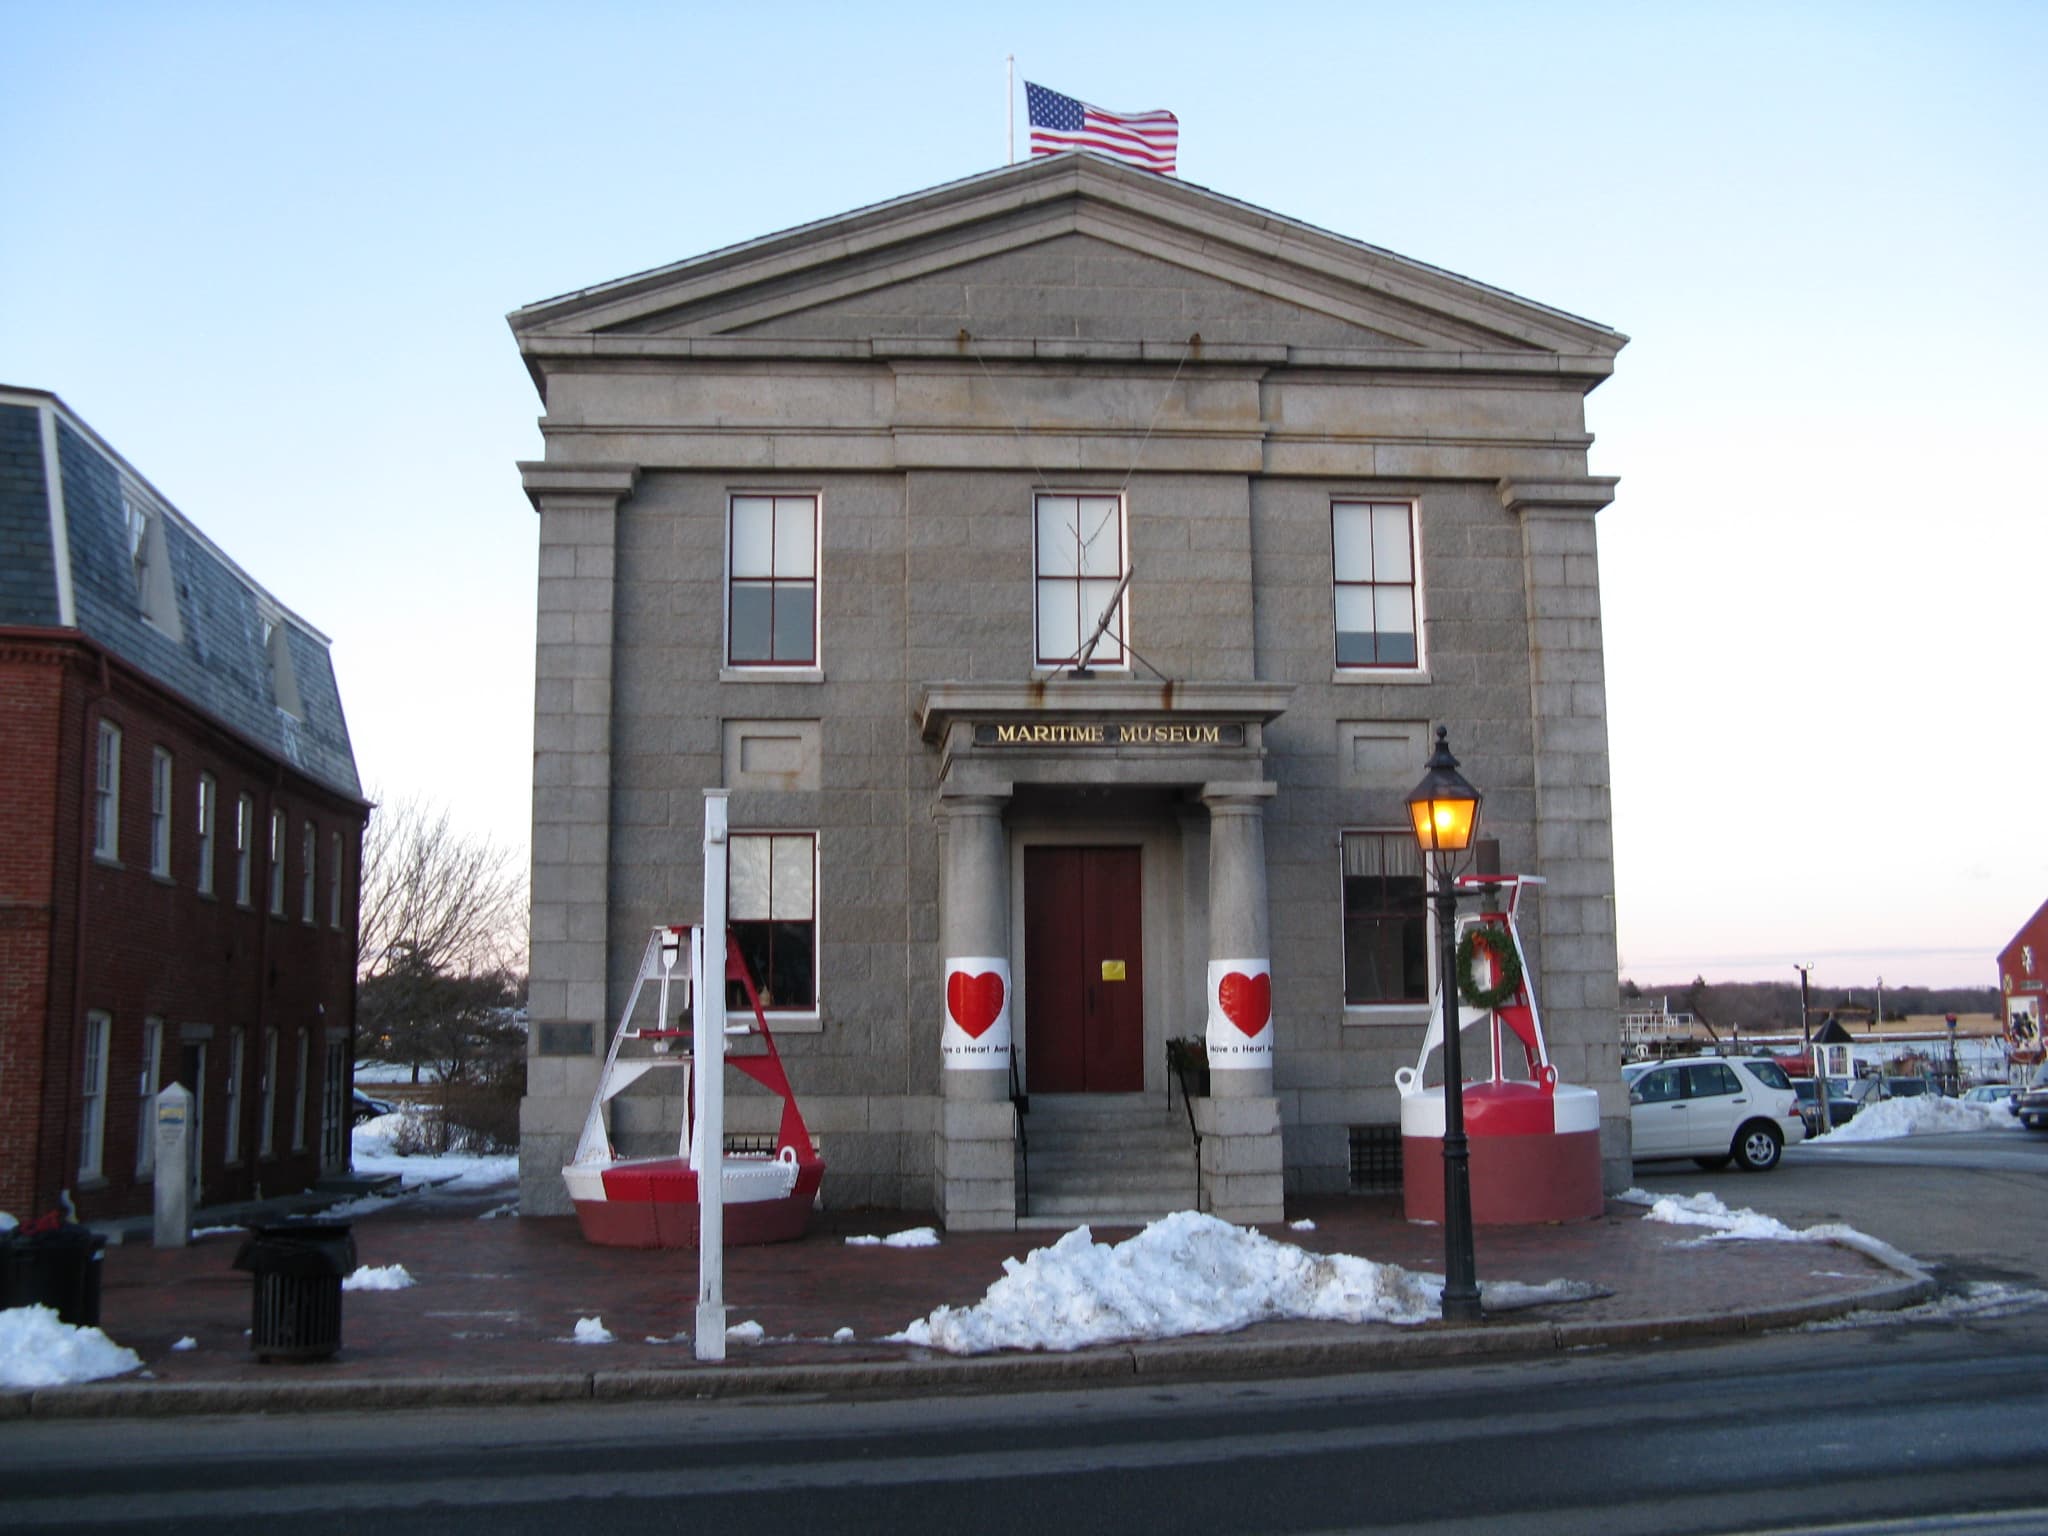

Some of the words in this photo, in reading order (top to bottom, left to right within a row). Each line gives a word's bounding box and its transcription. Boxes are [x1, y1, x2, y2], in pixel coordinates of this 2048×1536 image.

[997, 725, 1104, 742] MARITIME
[1119, 725, 1220, 742] MUSEUM
[964, 1044, 990, 1054] Heart
[1209, 1044, 1228, 1053] Have
[1242, 1044, 1265, 1054] Heart
